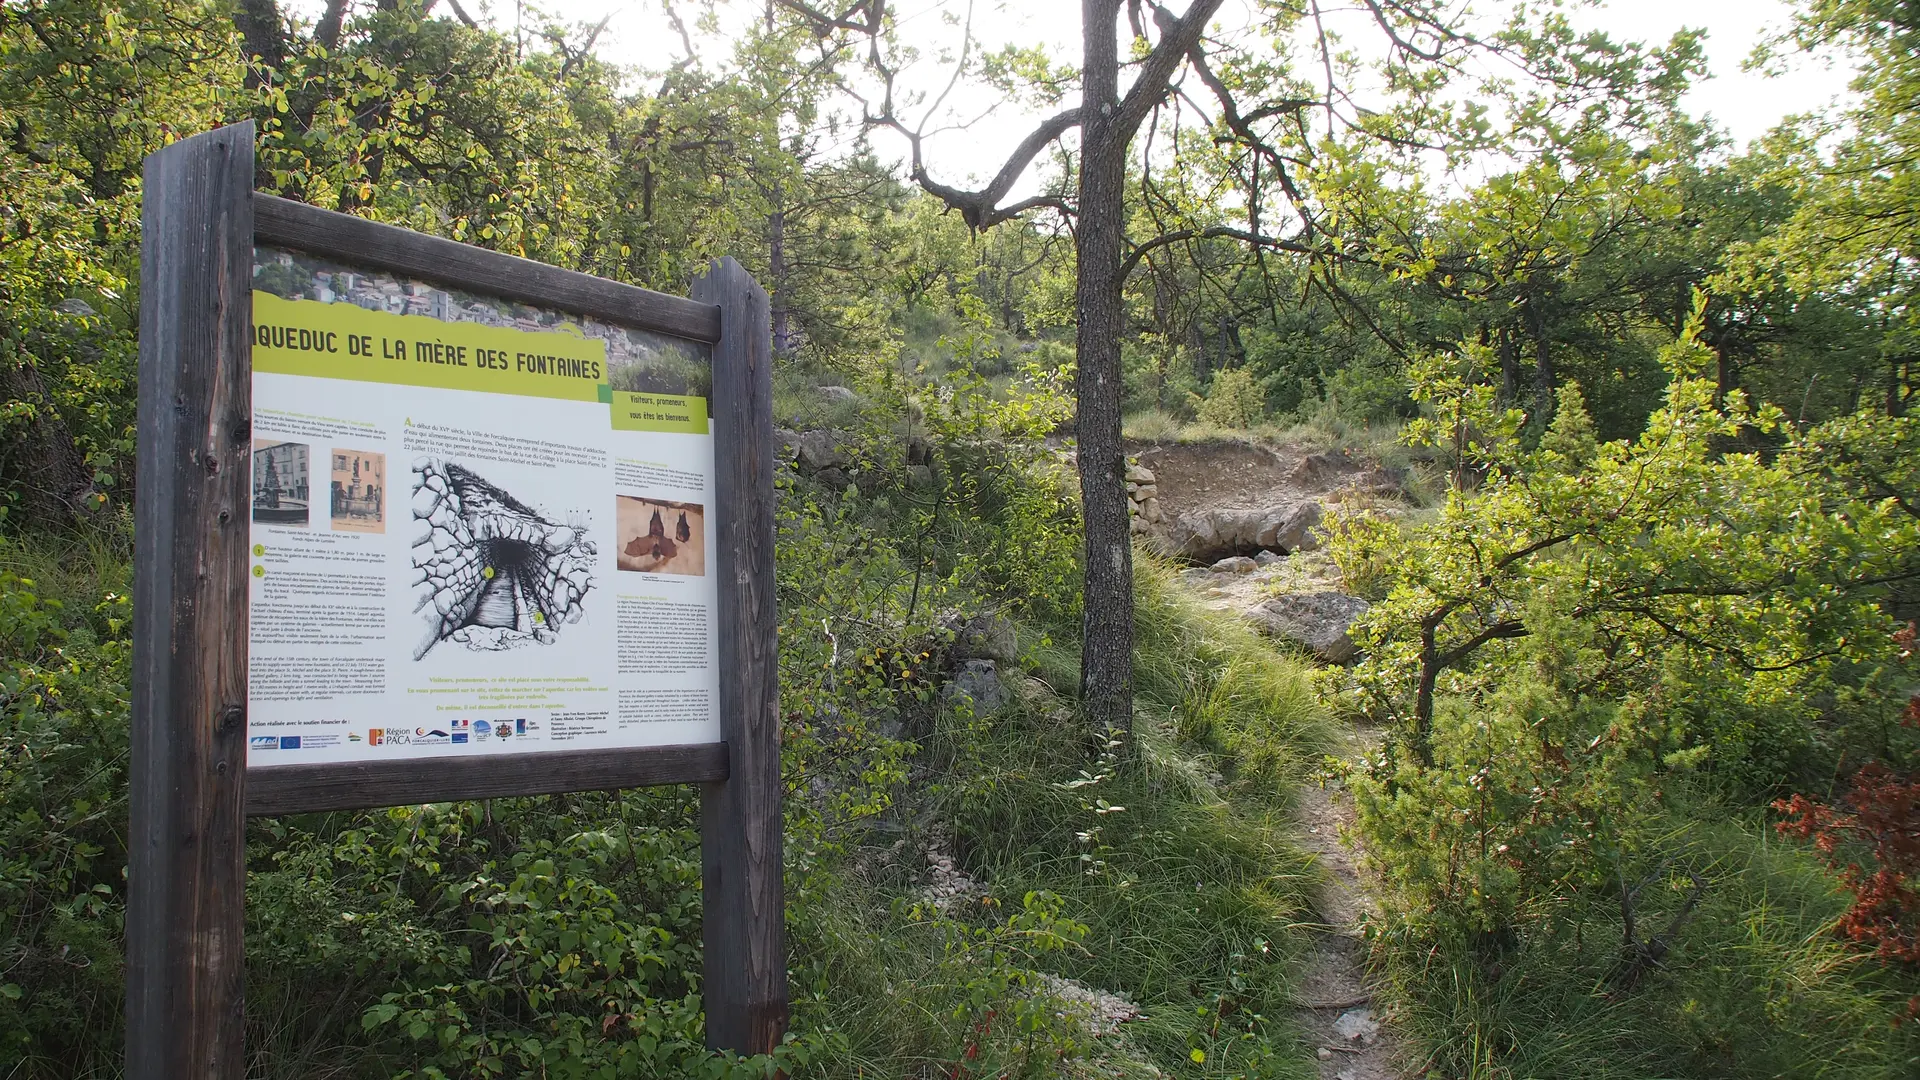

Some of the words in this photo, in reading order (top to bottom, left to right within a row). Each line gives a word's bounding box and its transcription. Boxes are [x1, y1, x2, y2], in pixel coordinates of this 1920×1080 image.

[348, 334, 372, 356] DE
[382, 338, 406, 360] LA
[416, 338, 468, 366] MÈRE
[476, 348, 508, 370] DES
[516, 352, 600, 380] FONTAINES
[630, 395, 655, 405] Visiteurs,
[656, 398, 688, 407] promeneurs,
[630, 412, 642, 420] vous
[643, 412, 654, 420] êtes
[665, 413, 690, 422] bienvenus.
[386, 728, 410, 736] Région
[386, 736, 410, 744] PACA
